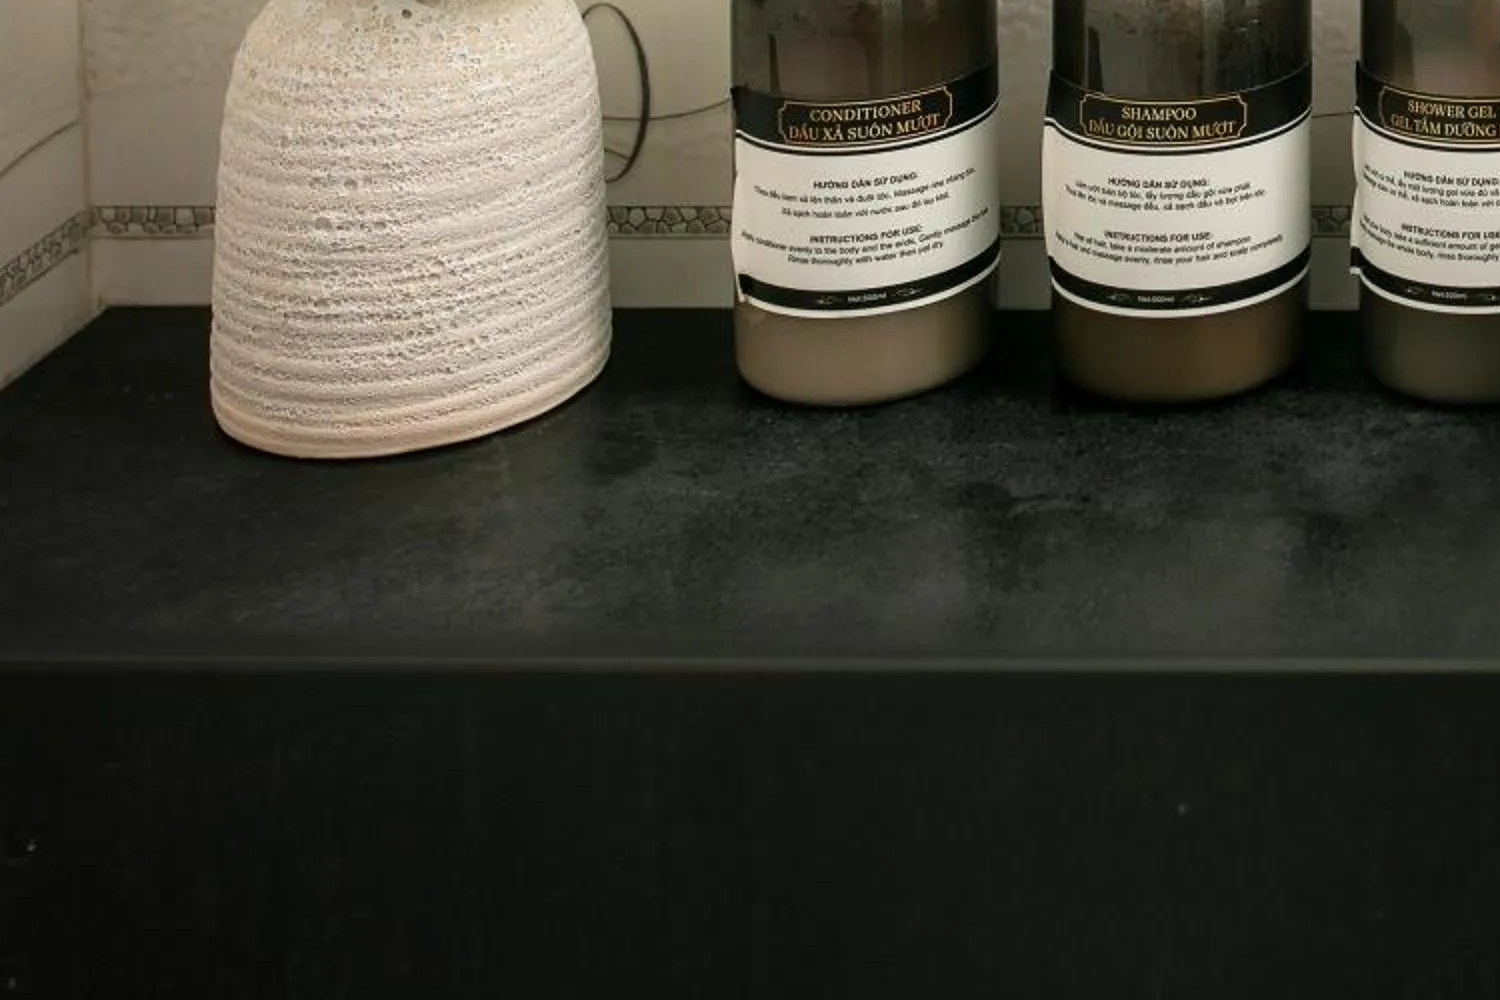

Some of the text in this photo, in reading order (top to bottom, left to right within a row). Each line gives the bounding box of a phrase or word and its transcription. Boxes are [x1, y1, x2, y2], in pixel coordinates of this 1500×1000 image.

[809, 100, 921, 122] CONDITIONER
[1121, 106, 1197, 121] SHAMPOO
[1407, 99, 1497, 119] SHOWER GEL
[1390, 113, 1412, 129] GEL
